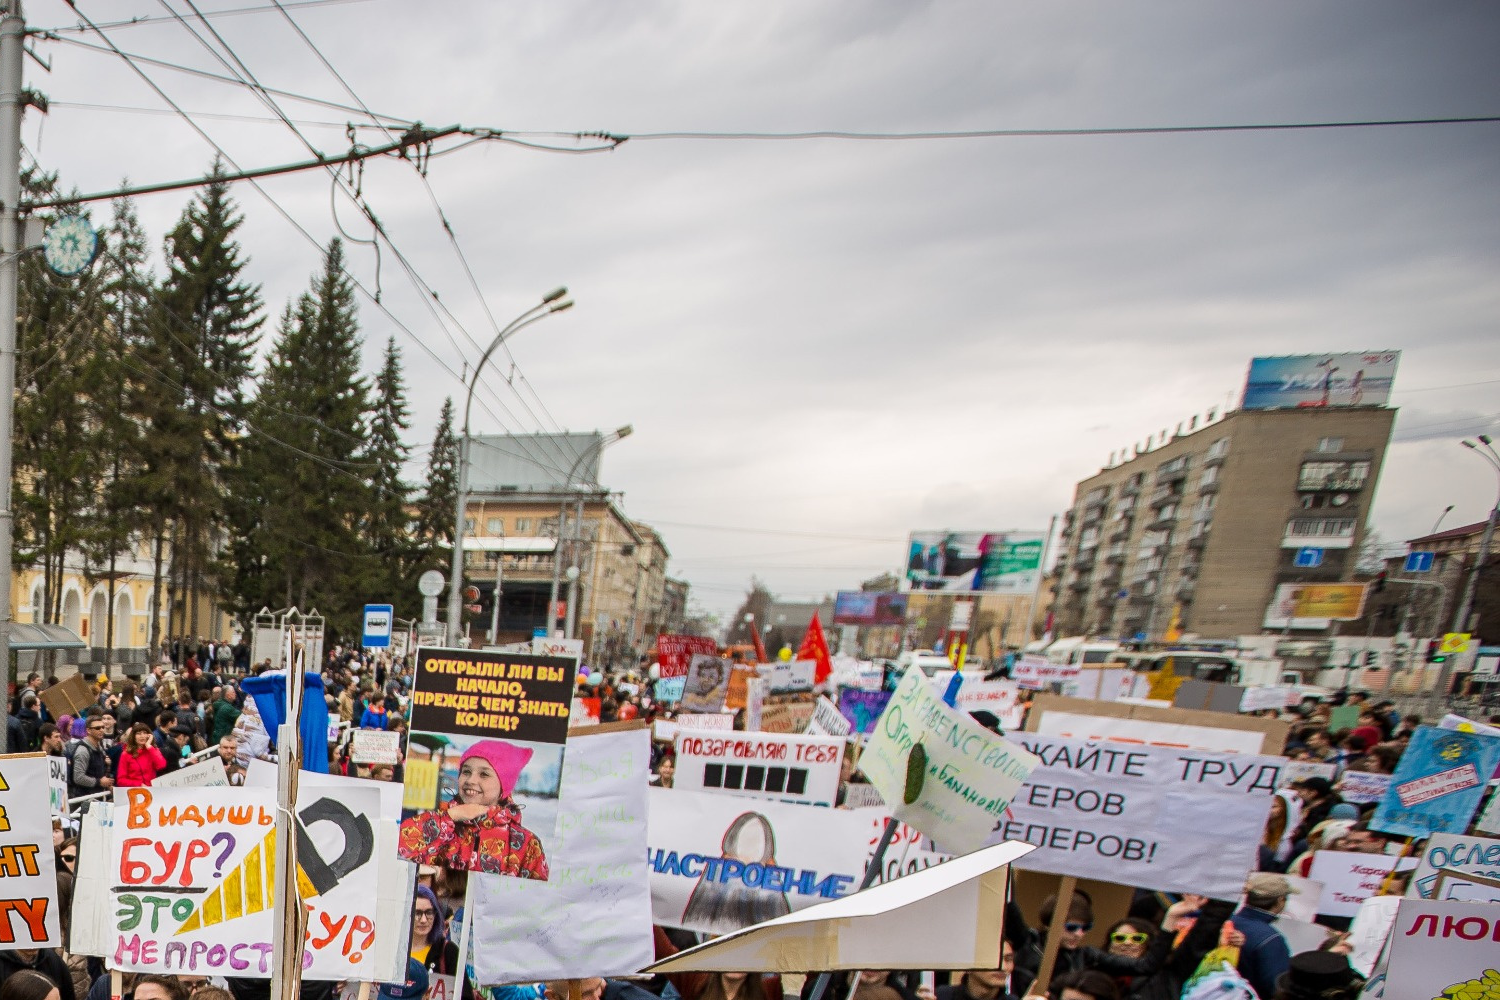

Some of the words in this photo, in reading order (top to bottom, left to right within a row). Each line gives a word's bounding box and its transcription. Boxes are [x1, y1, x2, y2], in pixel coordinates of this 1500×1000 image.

[425, 658, 506, 678] ОТКРЫЛИ
[507, 664, 533, 680] ЛИ
[536, 666, 565, 682] ВЫ
[456, 677, 526, 699] НАЧАЛО,
[414, 691, 479, 711] ПРЕЖДЕ
[482, 697, 515, 713] ЧЕМ
[517, 699, 569, 718] ЗНАТЬ
[455, 712, 520, 731] КОНЕЦ?
[126, 787, 273, 830] Видишь
[119, 831, 237, 888] БУР?
[648, 846, 855, 899] НАСТРОЕНИЕ
[115, 894, 195, 934] ЭТО
[1405, 914, 1500, 942] ЛЮ
